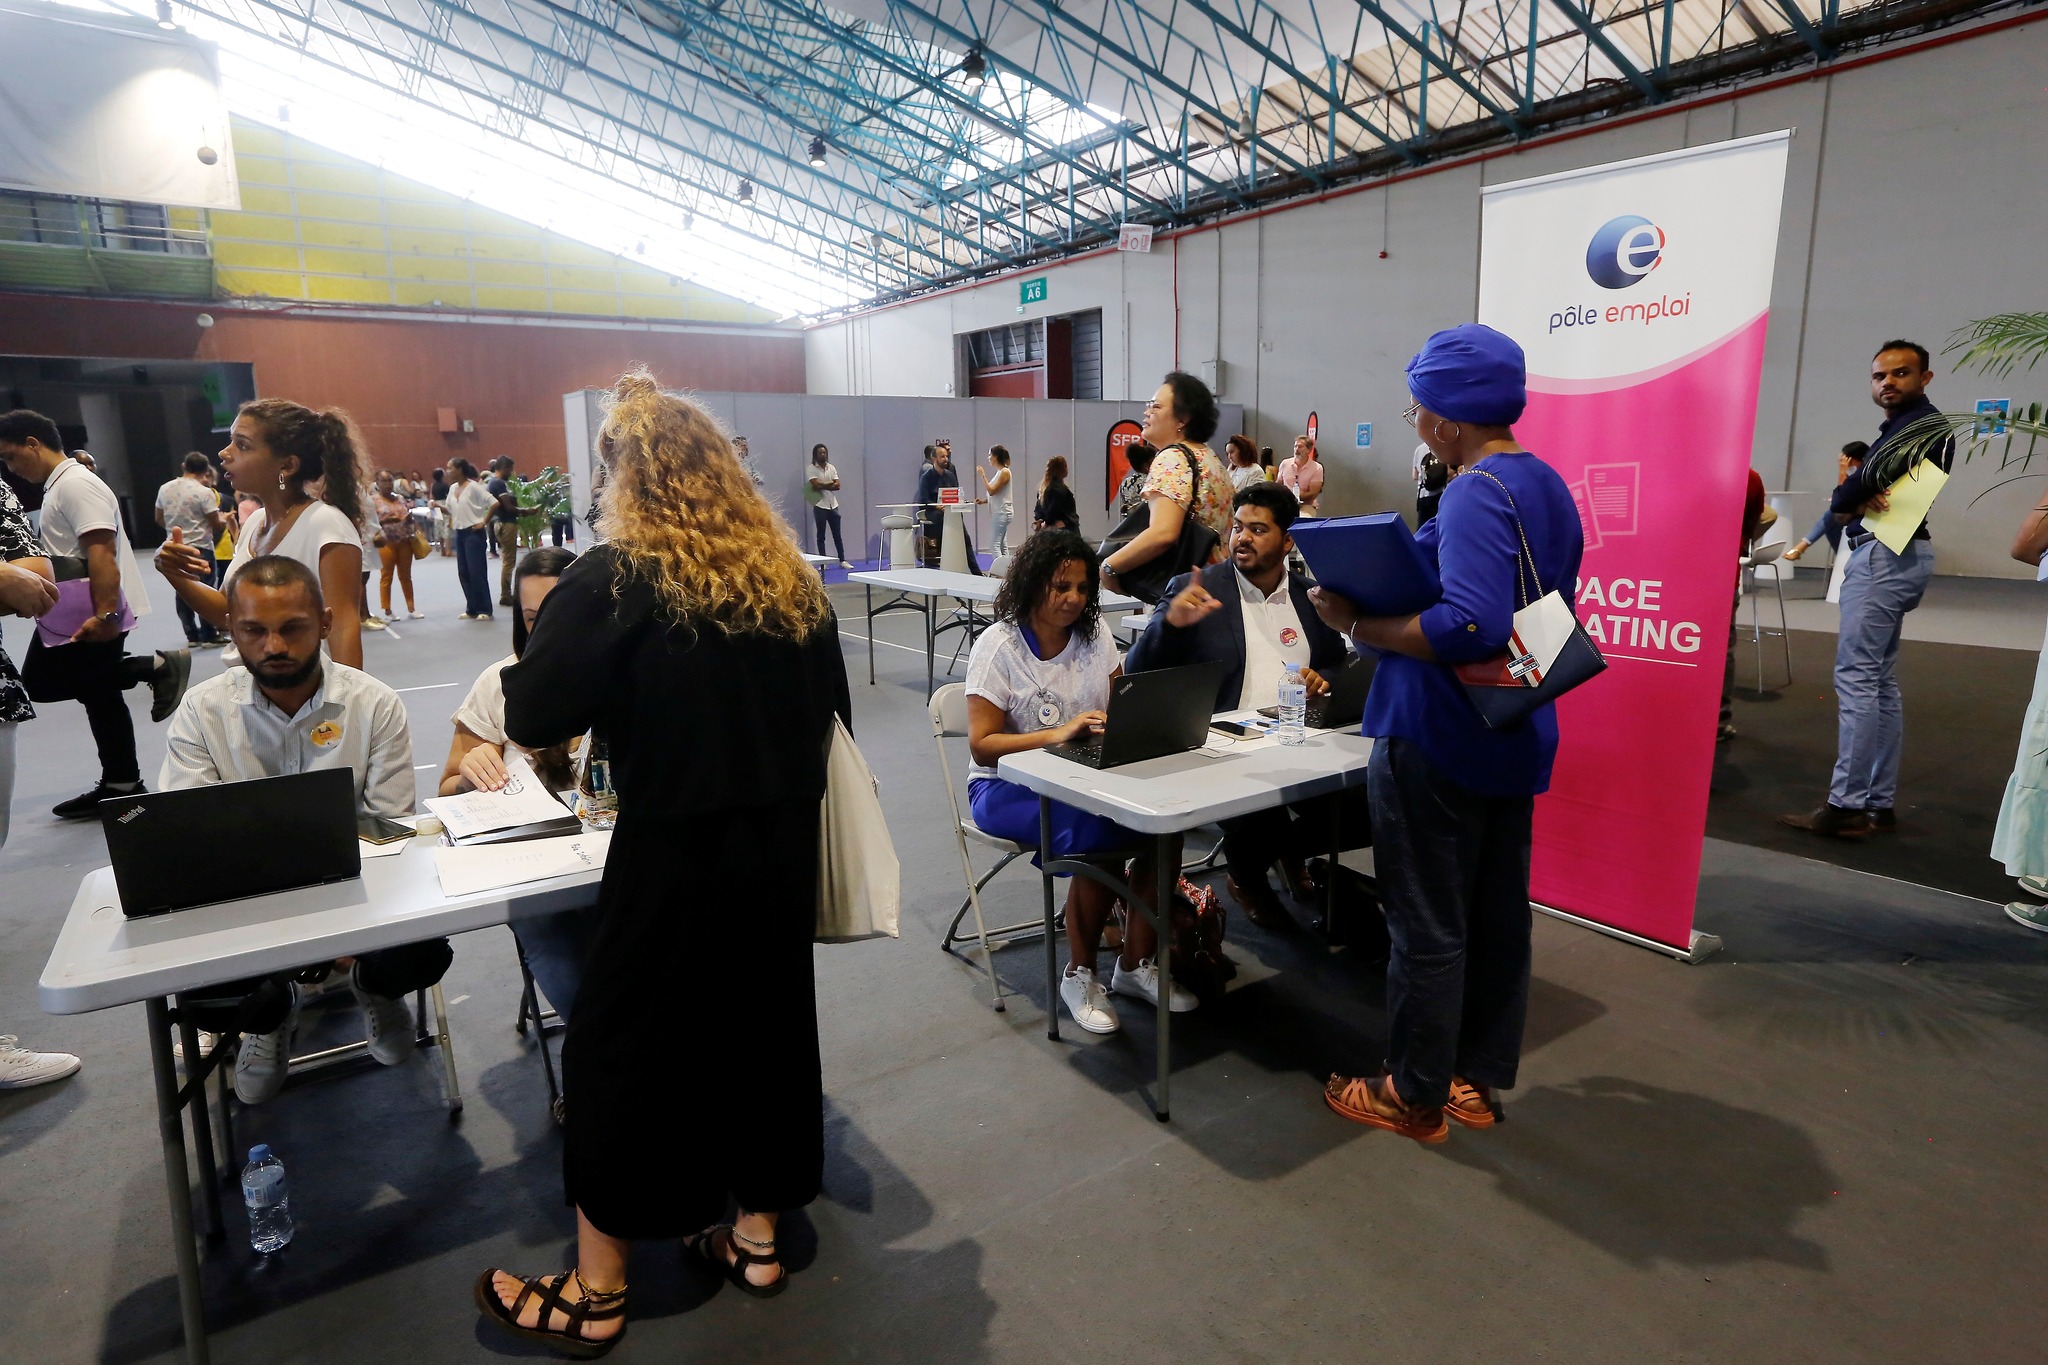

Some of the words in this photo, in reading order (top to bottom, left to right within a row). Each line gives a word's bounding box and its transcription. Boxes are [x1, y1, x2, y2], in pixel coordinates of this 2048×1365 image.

[1027, 286, 1041, 300] A6
[1549, 304, 1597, 334] pôle
[1605, 292, 1690, 325] emploi
[117, 804, 146, 824] ThinkPad
